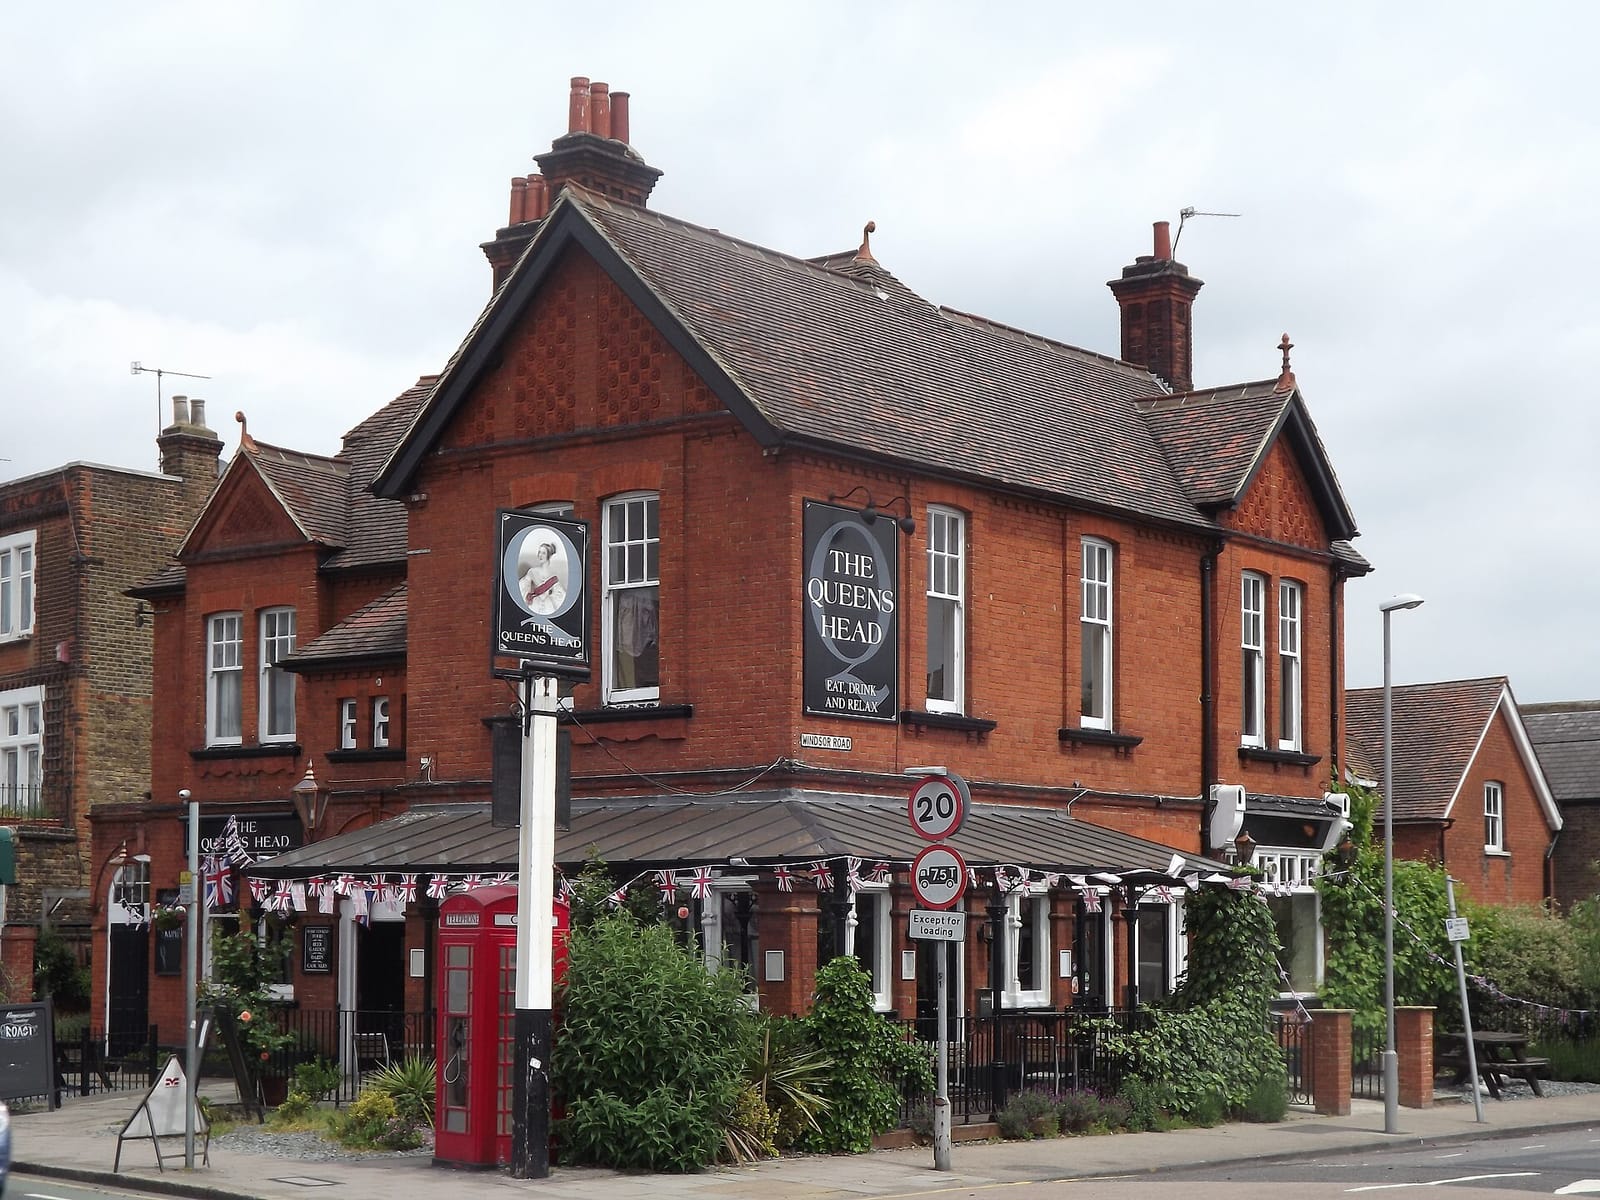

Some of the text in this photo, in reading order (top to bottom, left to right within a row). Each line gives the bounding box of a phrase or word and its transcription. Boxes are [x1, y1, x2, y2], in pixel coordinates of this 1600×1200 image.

[829, 550, 874, 579] THE
[807, 578, 894, 613] QUEENS
[530, 623, 553, 634] THE
[820, 614, 882, 645] HEAD
[501, 631, 582, 648] QUEENS HEAD
[827, 680, 877, 697] EAT, DRINK
[825, 696, 878, 713] AND RELAX
[802, 734, 850, 749] WINDSOR ROAD
[917, 793, 954, 823] 20
[201, 835, 290, 852] QUES HEAD
[913, 914, 961, 926] Except for
[920, 926, 953, 938] loading
